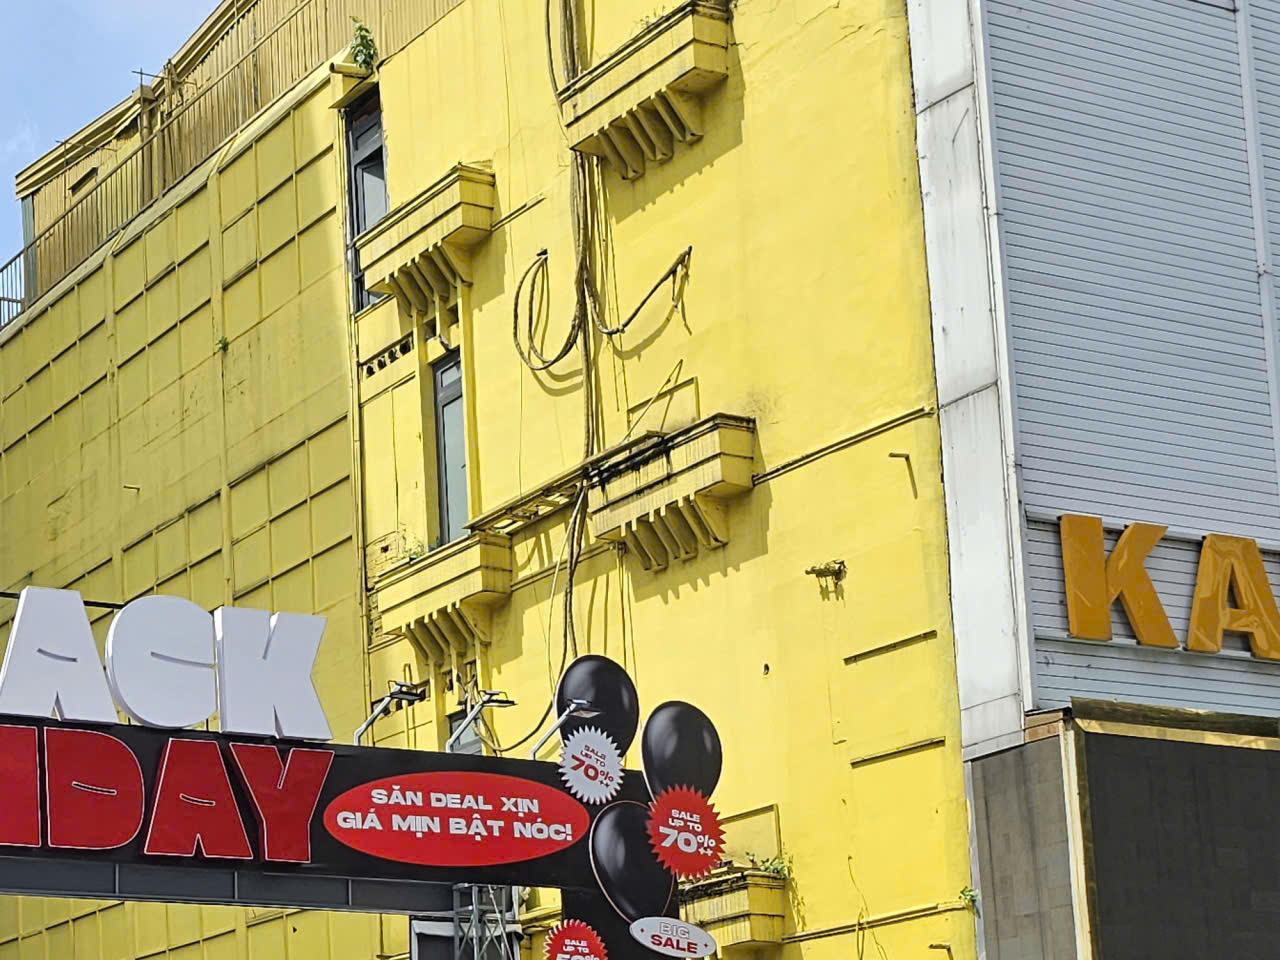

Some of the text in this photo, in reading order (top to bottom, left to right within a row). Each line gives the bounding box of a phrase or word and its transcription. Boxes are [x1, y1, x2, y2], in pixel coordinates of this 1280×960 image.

[1060, 514, 1280, 660] KA
[580, 751, 606, 768] UP TO
[584, 744, 607, 761] SALE
[371, 785, 539, 817] SĂN DEAL XỊN
[336, 807, 573, 841] GIÁ MỊN BẬT NÓC!
[671, 809, 701, 823] SALE
[668, 818, 703, 832] UP TO
[658, 921, 690, 939] BIG
[564, 939, 588, 947] SALE
[650, 934, 698, 954] SALE
